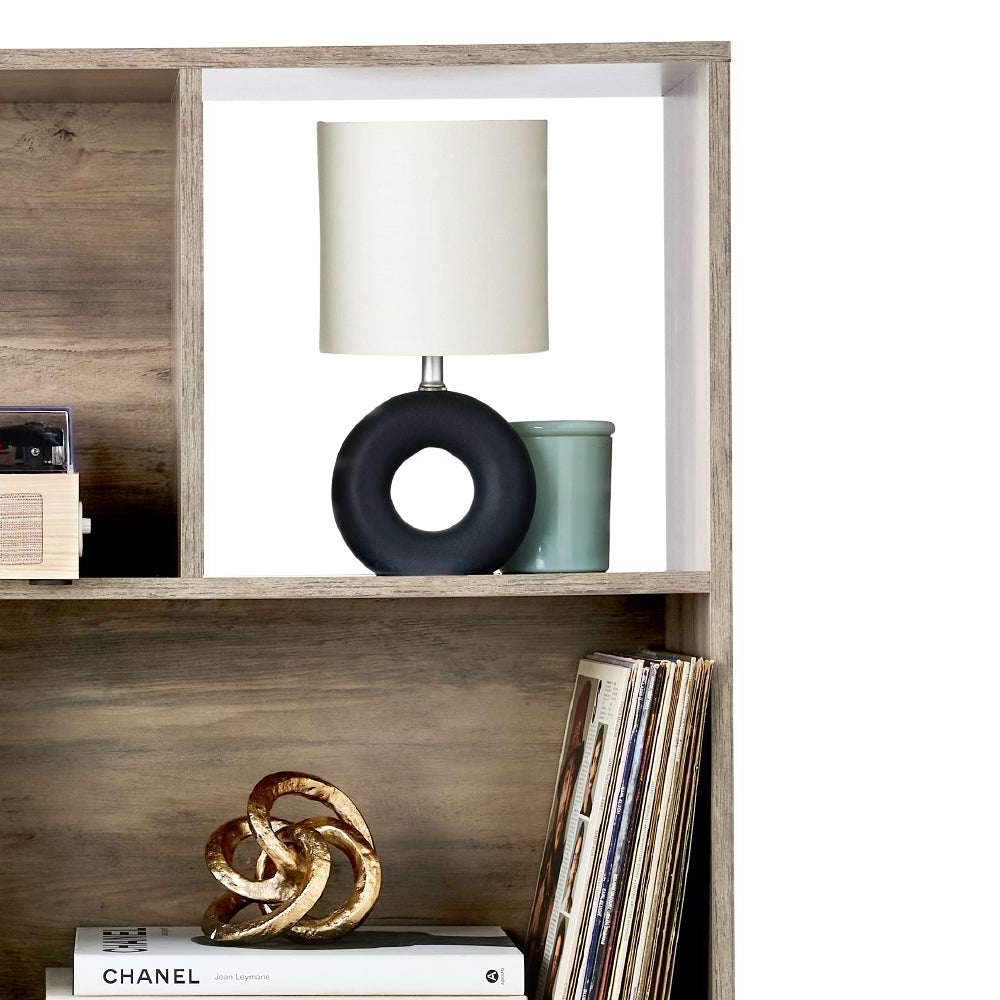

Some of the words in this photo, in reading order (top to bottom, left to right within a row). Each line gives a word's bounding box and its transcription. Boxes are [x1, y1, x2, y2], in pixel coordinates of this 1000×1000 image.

[102, 968, 200, 985] CHANEL
[214, 972, 234, 982] Jean
[235, 972, 271, 984] Leymarie
